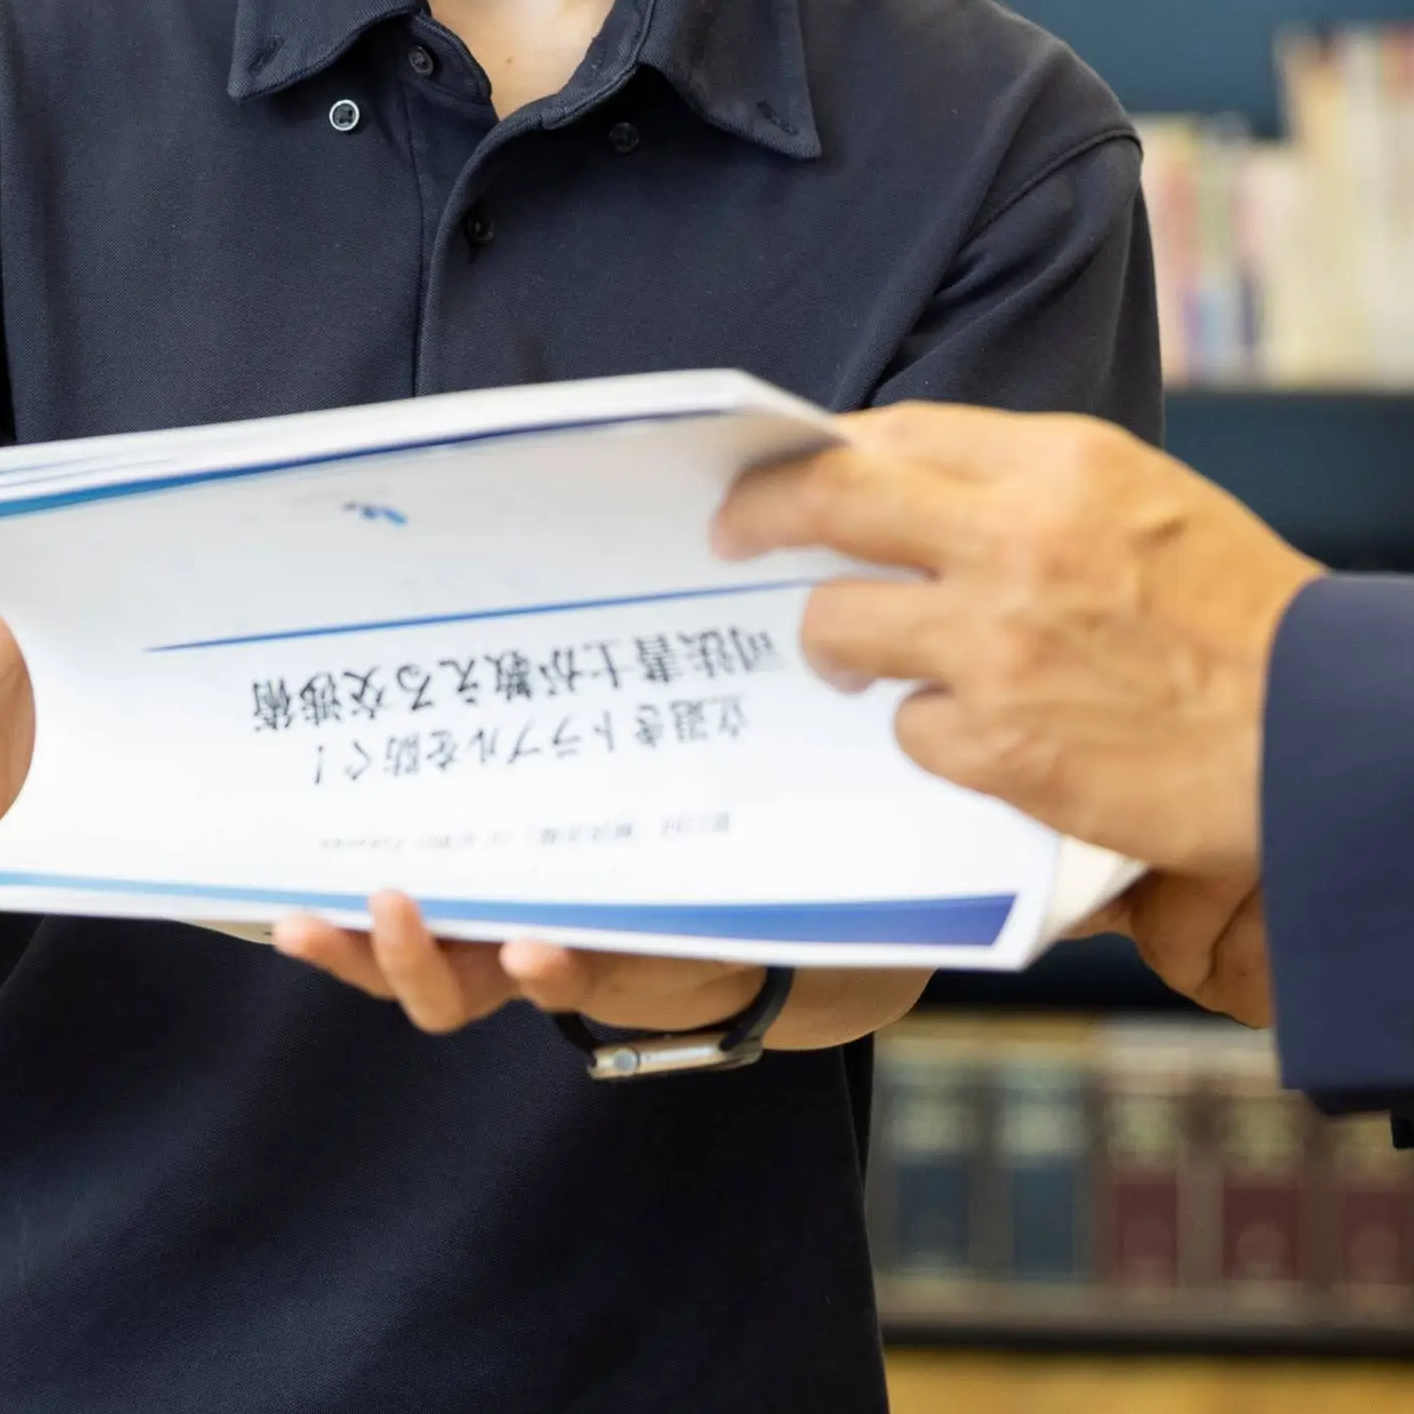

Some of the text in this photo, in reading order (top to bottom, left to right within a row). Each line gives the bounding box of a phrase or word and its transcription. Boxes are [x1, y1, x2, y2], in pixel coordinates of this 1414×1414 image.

[252, 626, 776, 732] 司法書士が教える交渉術
